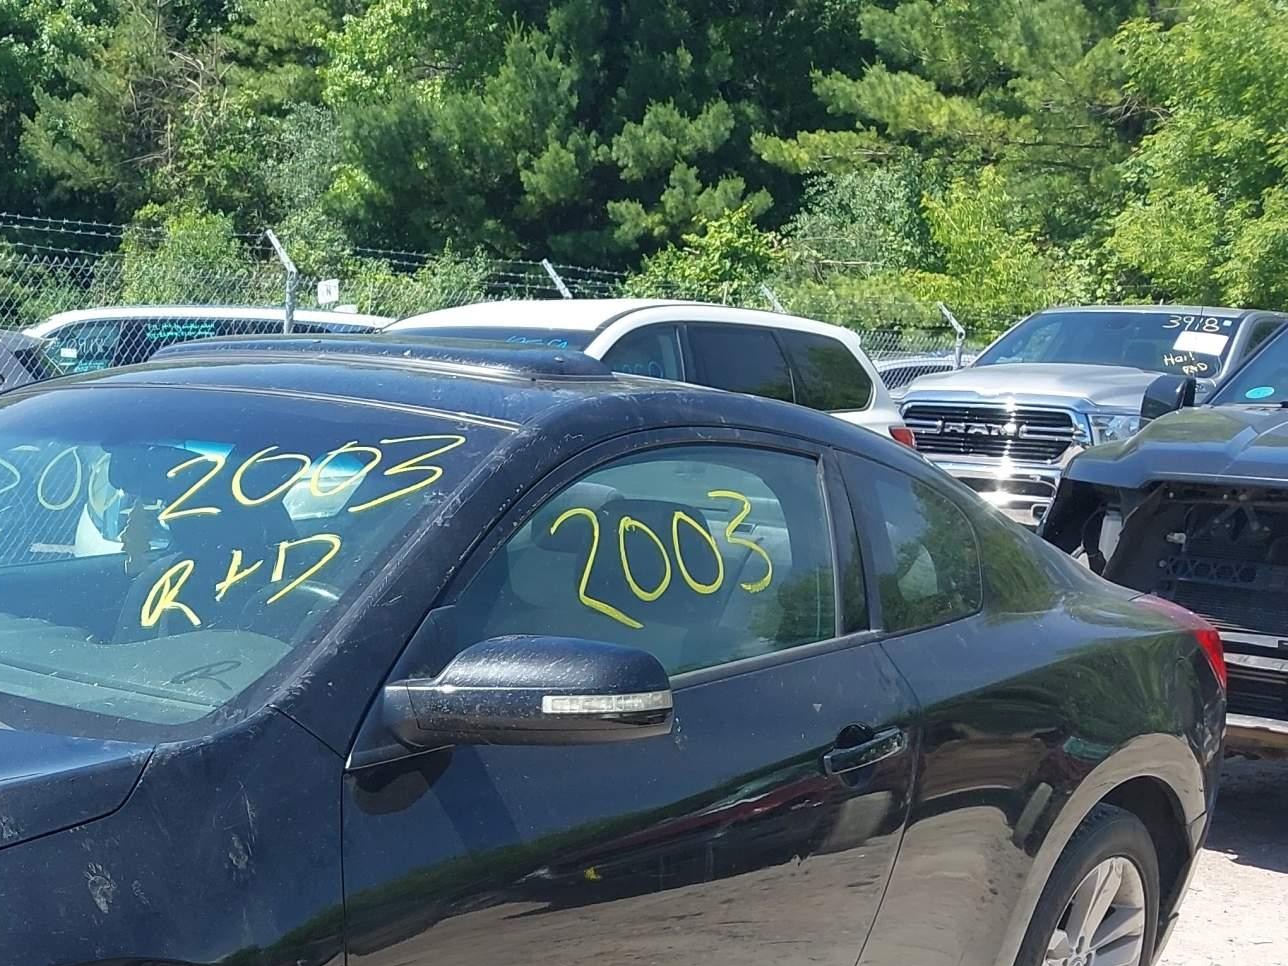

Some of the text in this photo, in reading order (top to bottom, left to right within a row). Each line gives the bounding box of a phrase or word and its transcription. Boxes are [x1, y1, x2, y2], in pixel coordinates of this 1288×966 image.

[1162, 315, 1220, 333] 3918
[943, 421, 1017, 437] RAM
[157, 434, 467, 523] 2003
[550, 488, 774, 629] 2003
